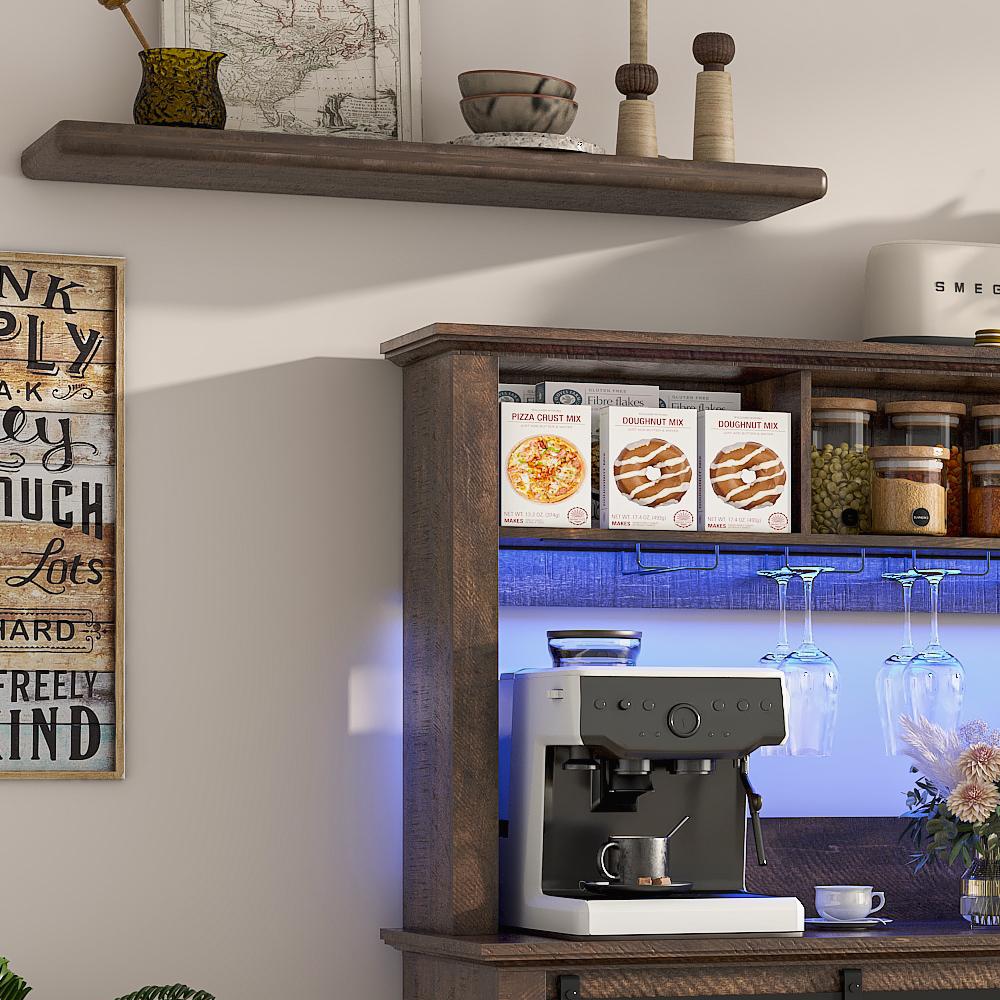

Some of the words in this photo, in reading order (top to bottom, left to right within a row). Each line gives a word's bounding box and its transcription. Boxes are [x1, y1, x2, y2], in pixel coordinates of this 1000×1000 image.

[587, 395, 614, 406] Fibre
[616, 396, 645, 407] flakes
[511, 412, 535, 421] PIZZA
[536, 413, 565, 422] CRUST
[566, 415, 582, 423] MIX
[622, 416, 667, 426] DOUGHNUT
[668, 418, 684, 427] MIX
[718, 420, 762, 429] DOUGHNUT
[763, 421, 779, 430] MIX
[5, 537, 104, 595] Lots
[0, 619, 75, 642] ARD
[0, 705, 101, 761] IND
